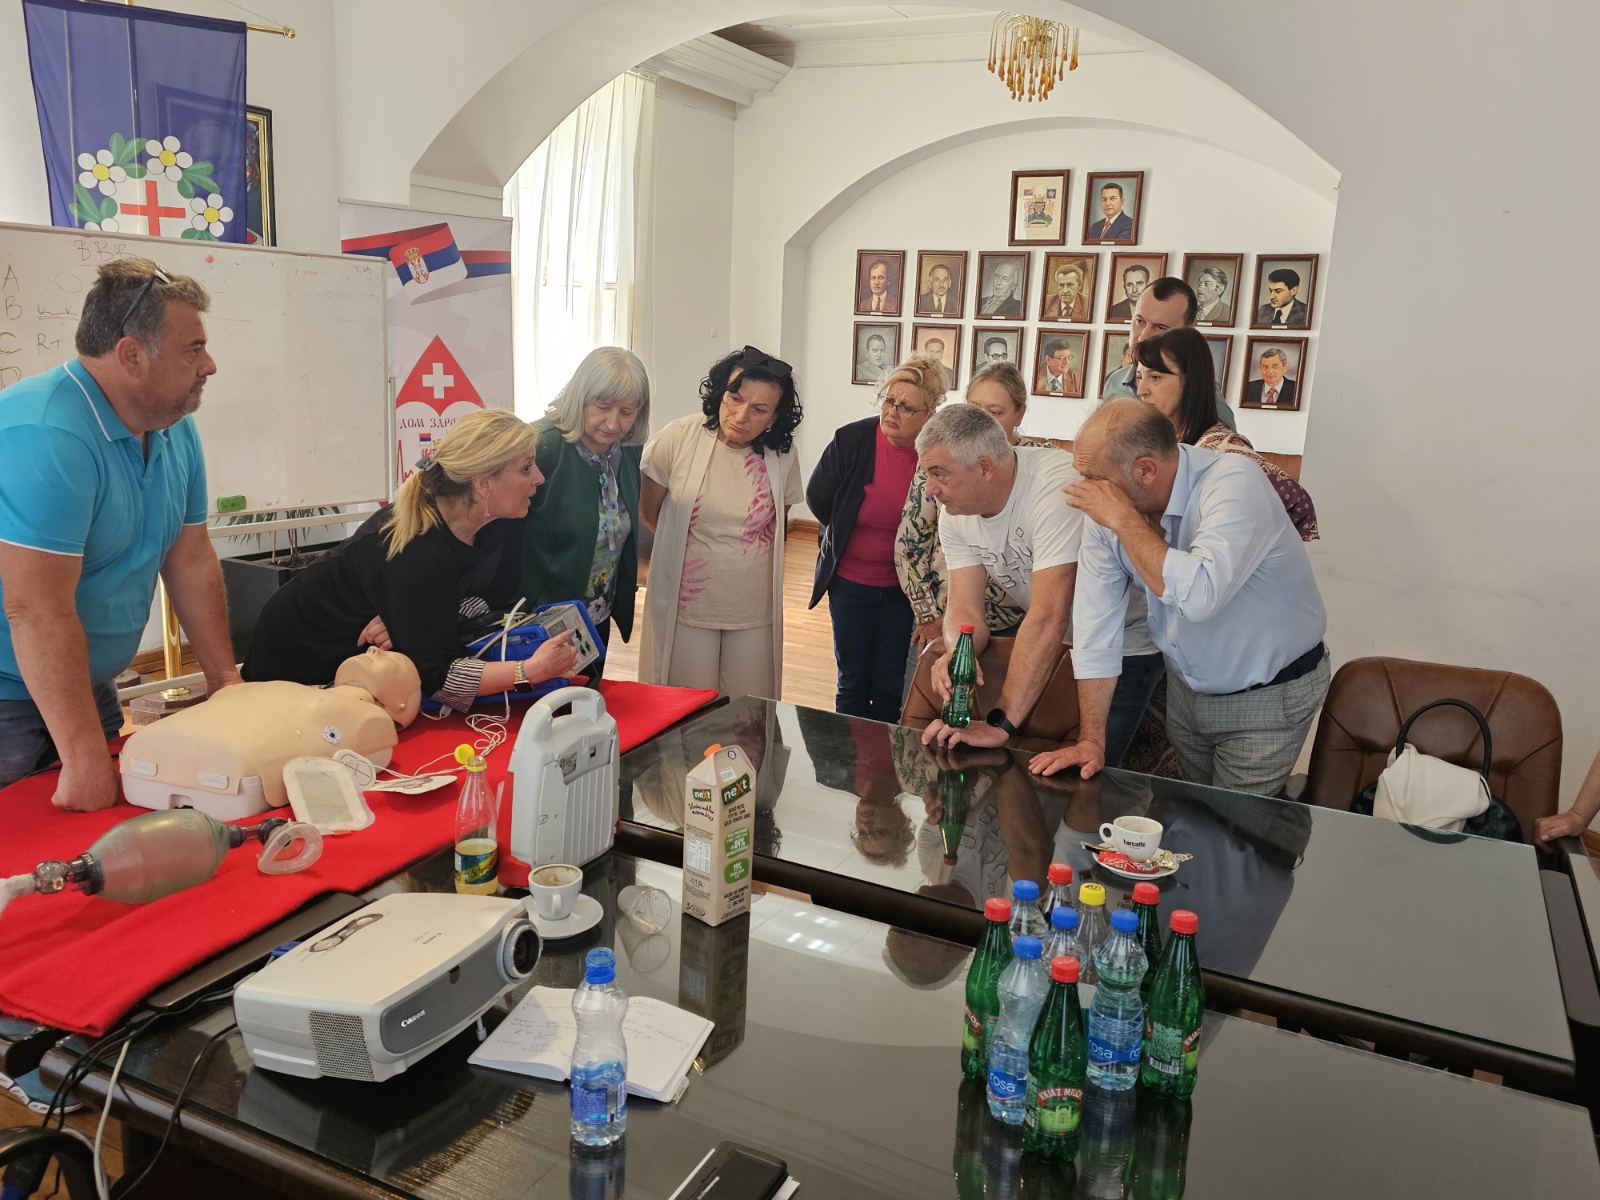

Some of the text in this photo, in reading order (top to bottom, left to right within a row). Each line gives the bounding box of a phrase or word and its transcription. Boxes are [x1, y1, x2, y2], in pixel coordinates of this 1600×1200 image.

[399, 418, 425, 429] ДОМ
[401, 1009, 426, 1028] Canon
[990, 1072, 1016, 1093] rosa
